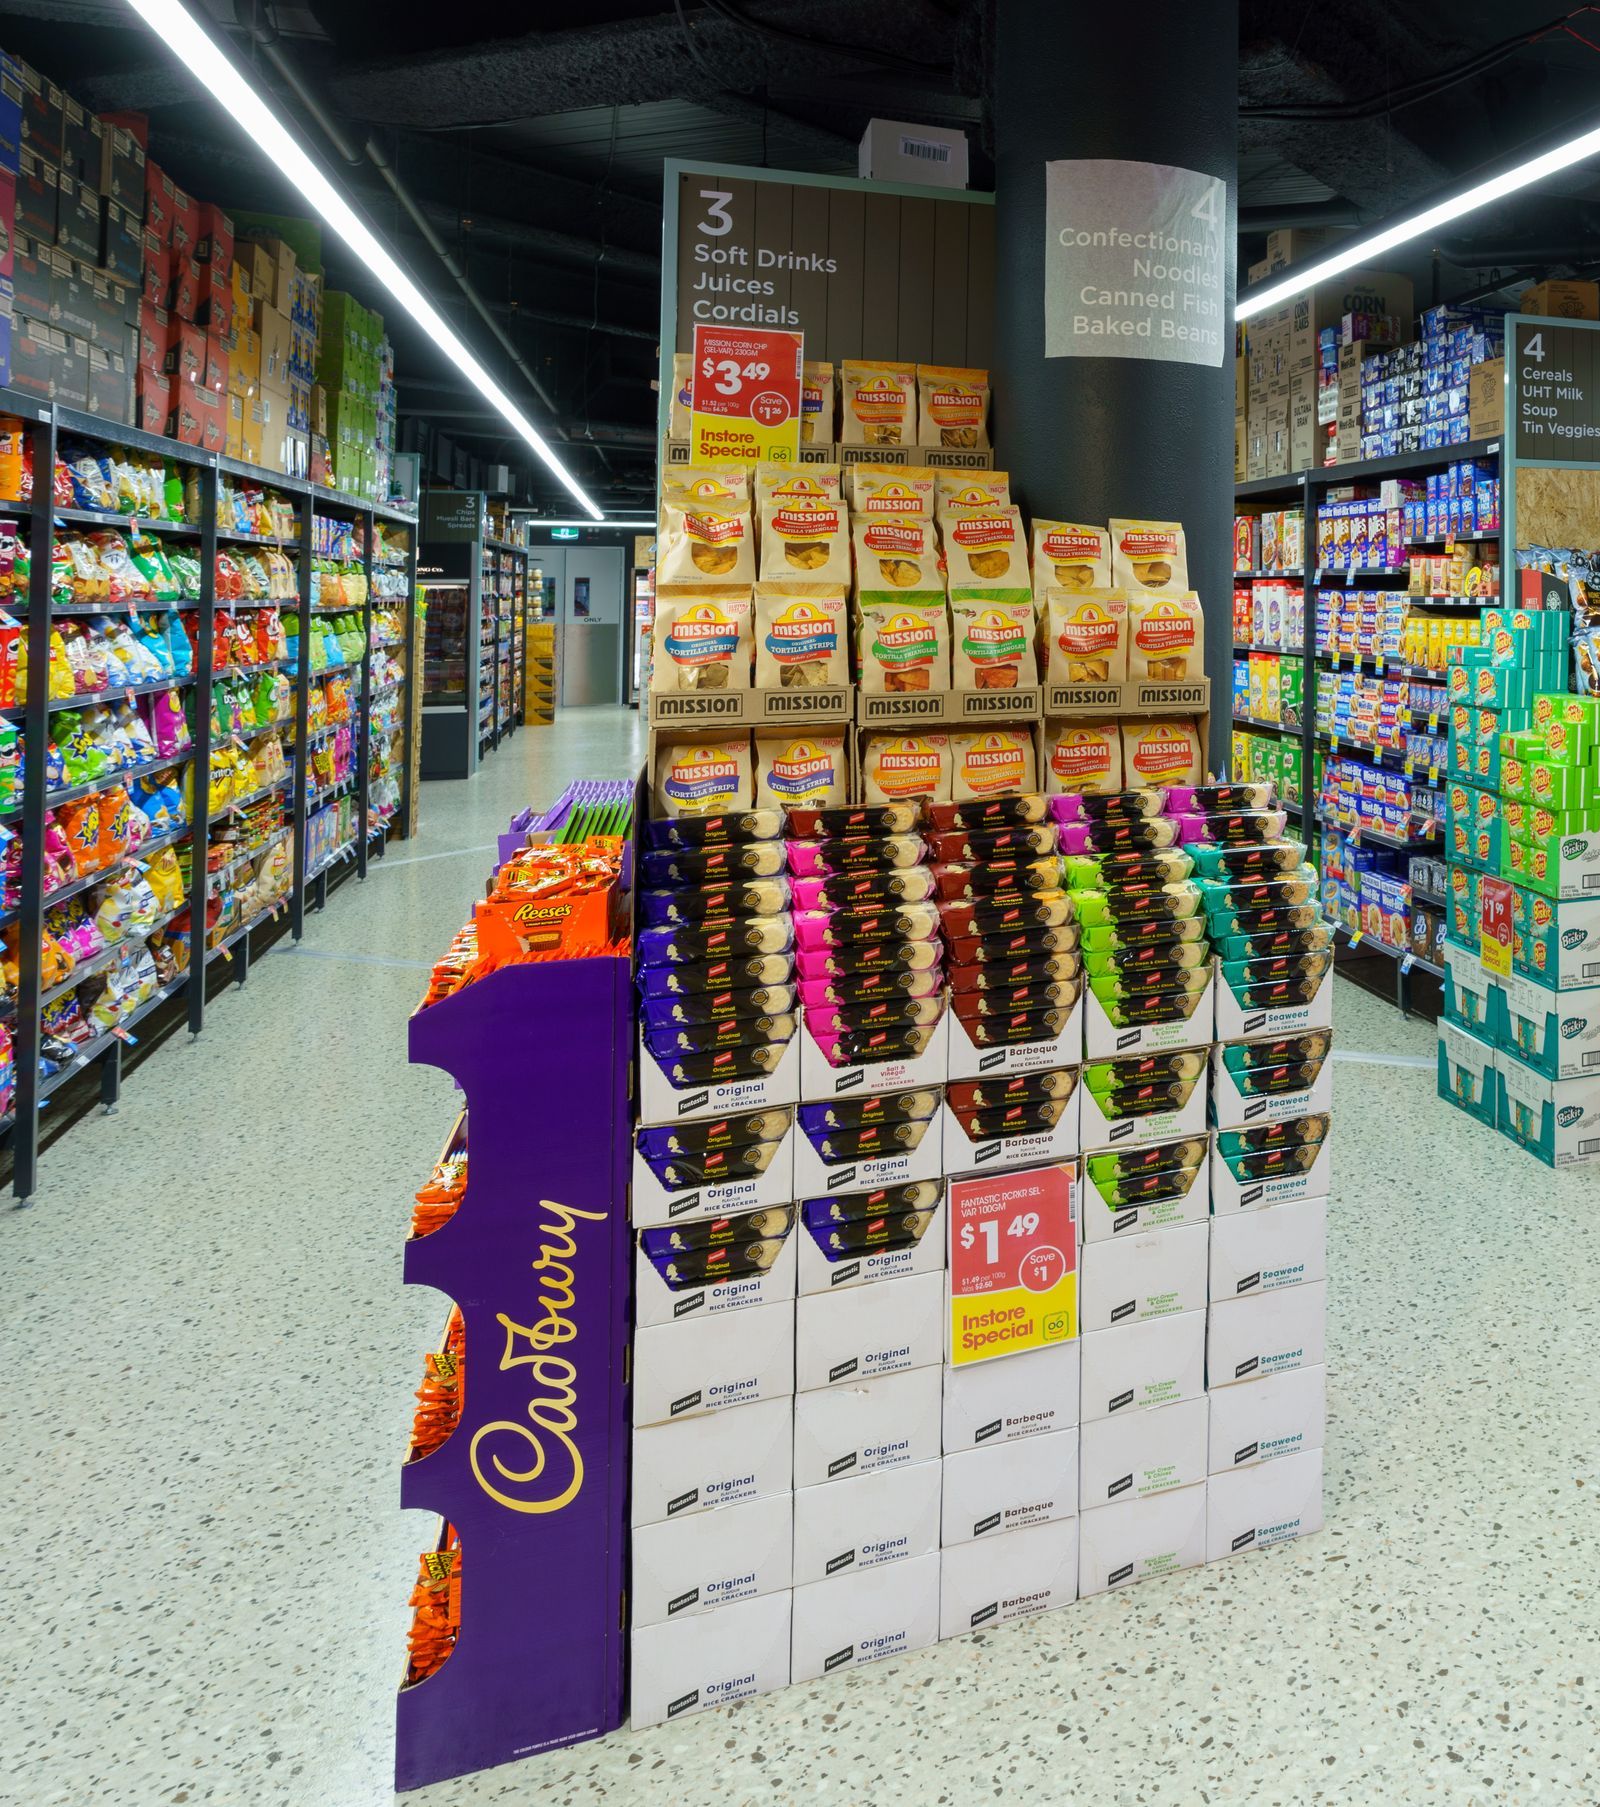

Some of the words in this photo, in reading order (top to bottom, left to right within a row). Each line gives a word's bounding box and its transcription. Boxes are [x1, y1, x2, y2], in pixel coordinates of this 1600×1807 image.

[697, 190, 733, 236] 3
[1190, 186, 1218, 232] 4
[1059, 227, 1219, 263] Confectionary
[694, 243, 748, 266] Soft
[758, 249, 837, 273] Drinks
[1133, 258, 1218, 289] Noodles
[693, 272, 774, 295] Juices
[1080, 286, 1175, 309] Canned
[1183, 293, 1218, 317] Fish
[693, 300, 799, 325] Cordials
[1073, 315, 1151, 337] Baked
[1161, 319, 1218, 346] Beans
[1523, 333, 1546, 363] 4
[1522, 367, 1573, 383] Cereals
[760, 396, 782, 405] Save
[1523, 385, 1552, 399] UHT
[1557, 388, 1583, 401] Milk
[1523, 404, 1558, 419] Soup
[701, 428, 754, 443] Instore
[1523, 421, 1543, 434] Tin
[1548, 423, 1600, 439] Veggies
[700, 443, 760, 458] Special
[844, 450, 905, 465] MISSION
[927, 454, 985, 468] MISSION
[465, 496, 475, 508] 3
[768, 695, 842, 711] MISSION
[966, 695, 1034, 711] MISSION
[1053, 689, 1118, 704] MISSION
[1141, 688, 1201, 702] MISSION
[659, 698, 738, 714] MISSION
[868, 699, 940, 714] MISSION
[1563, 841, 1586, 855] Biskit
[513, 903, 573, 921] Reese's
[1562, 930, 1586, 945] Biskit
[1268, 1010, 1309, 1022] Seaweed
[1010, 1043, 1058, 1057] Barbeque
[716, 1083, 764, 1097] Original
[680, 1095, 708, 1111] Fantastic
[863, 1159, 908, 1173] Original
[828, 1170, 855, 1186] Fantastic
[1265, 1179, 1307, 1193] Seaweed
[961, 1193, 1000, 1208] FANTASTIC
[1028, 1187, 1040, 1195] SEL
[961, 1208, 977, 1217] VAR
[978, 1202, 1006, 1214] 100GM
[1030, 1253, 1056, 1265] Save
[1034, 1266, 1047, 1281] $1
[963, 1306, 1026, 1331] Instore
[962, 1319, 1034, 1351] Special
[470, 1197, 607, 1514] Cadbury
[1006, 1410, 1055, 1427] Barbeque
[861, 1631, 906, 1651] Original
[669, 1694, 698, 1714] Fantastic
